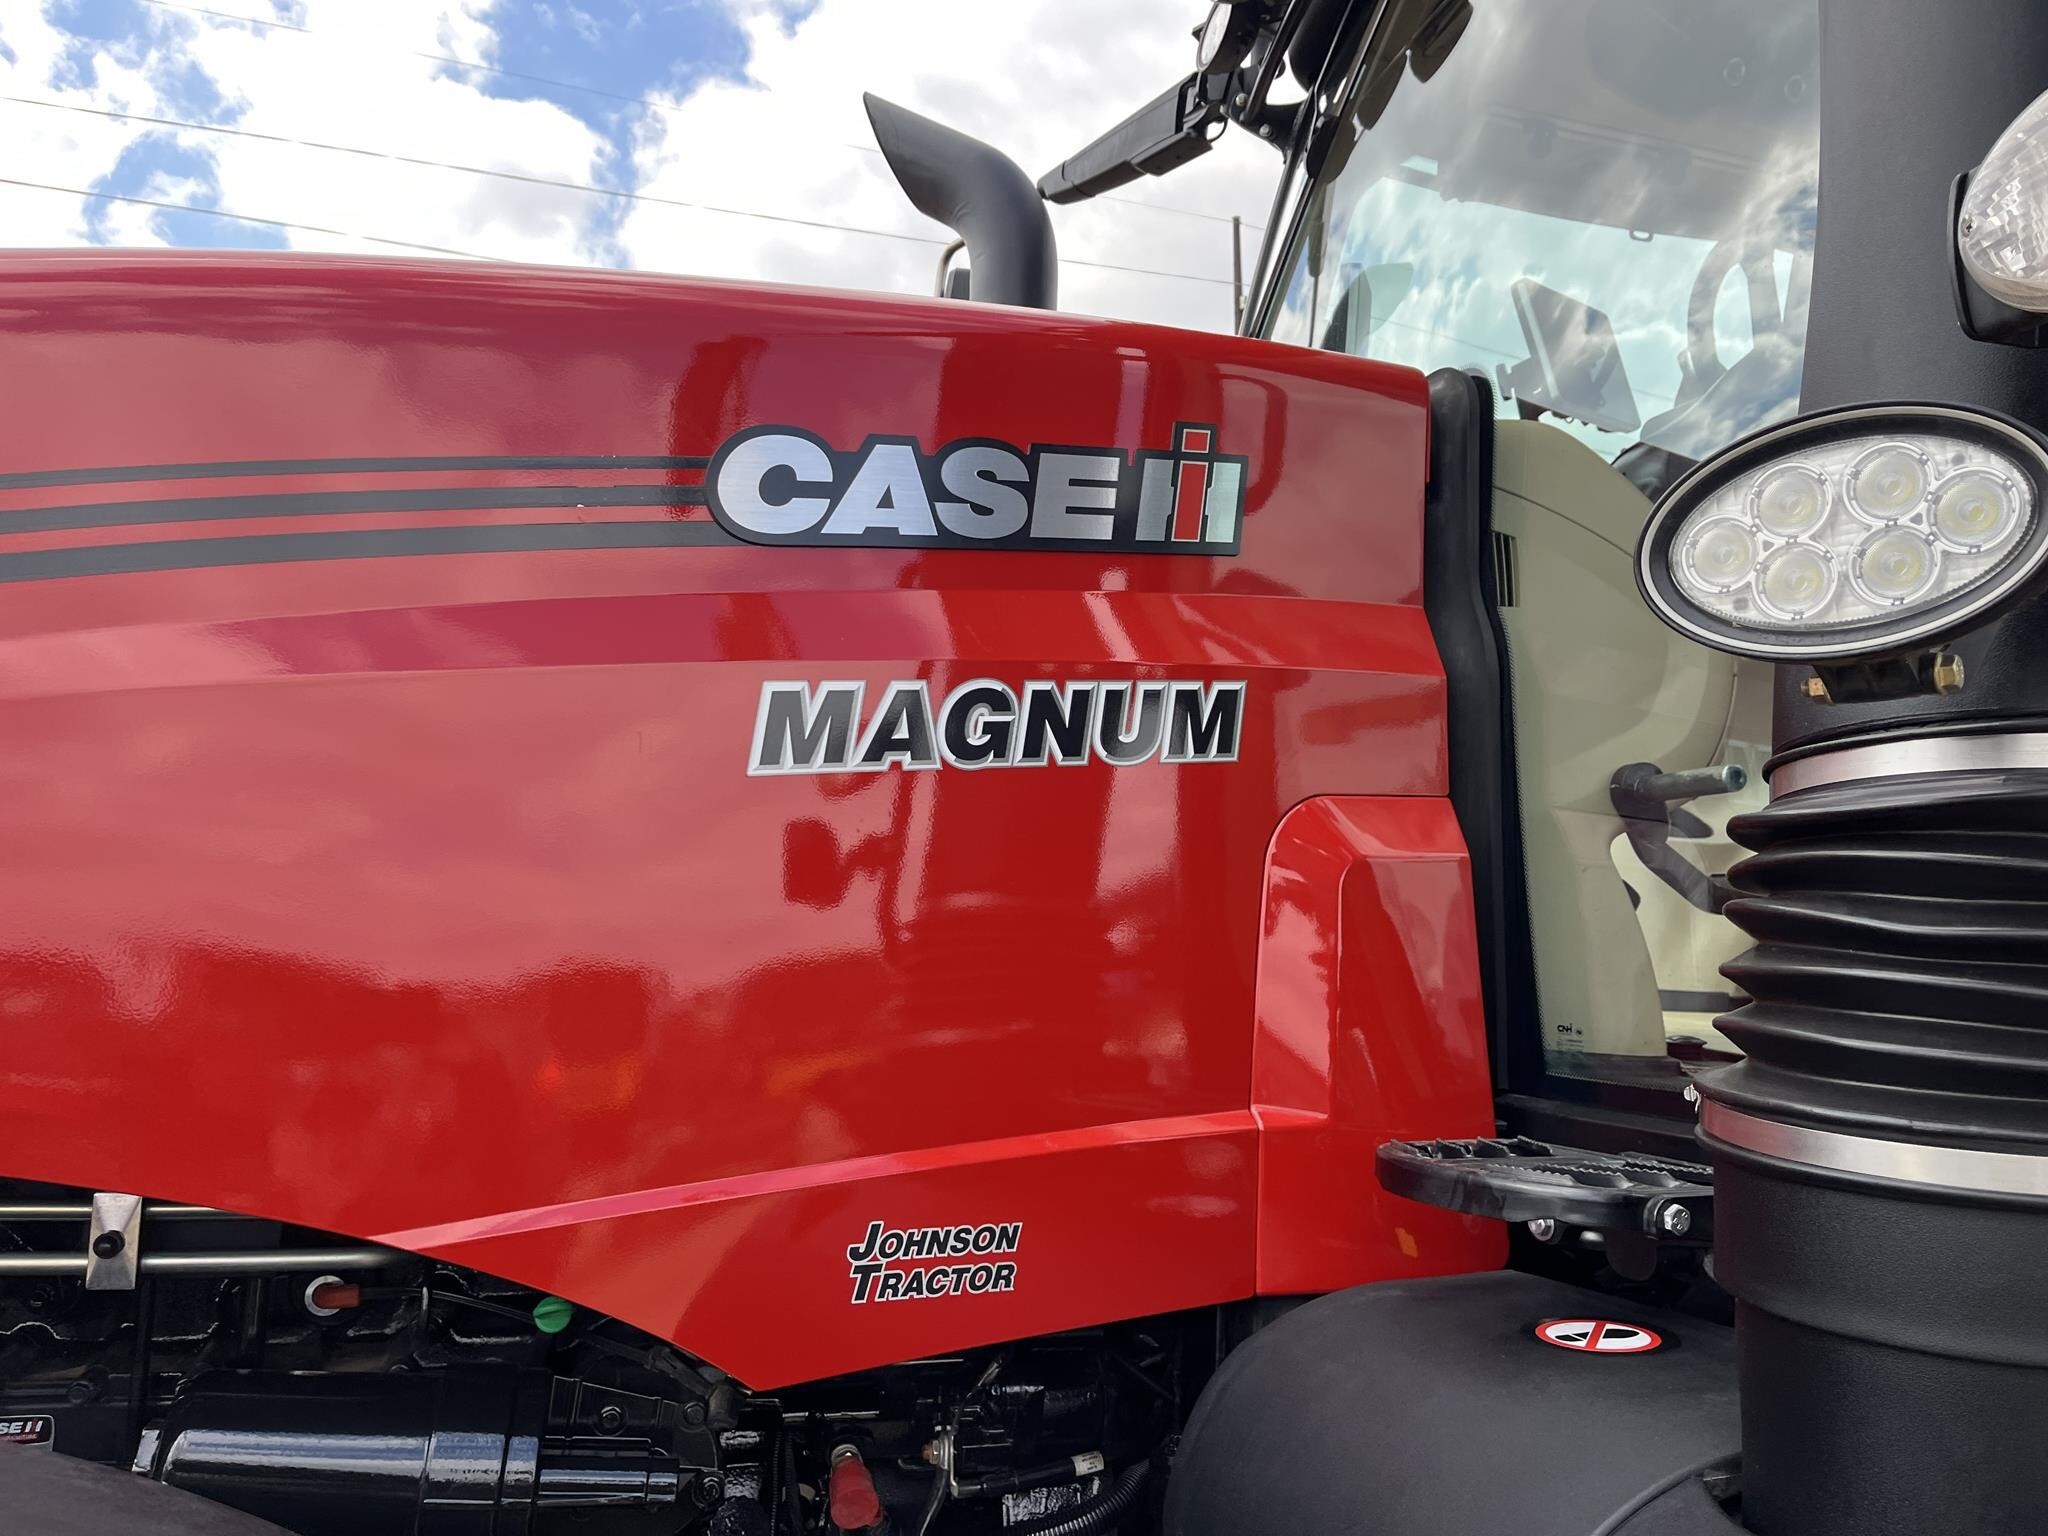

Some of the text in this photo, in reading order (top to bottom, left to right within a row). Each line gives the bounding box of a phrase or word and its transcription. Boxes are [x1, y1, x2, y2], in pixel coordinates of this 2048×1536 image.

[717, 433, 1121, 540] CASE
[747, 679, 1248, 776] MAGNUM
[847, 1221, 1023, 1264] JOHNSON
[850, 1261, 1017, 1304] TRACTOR
